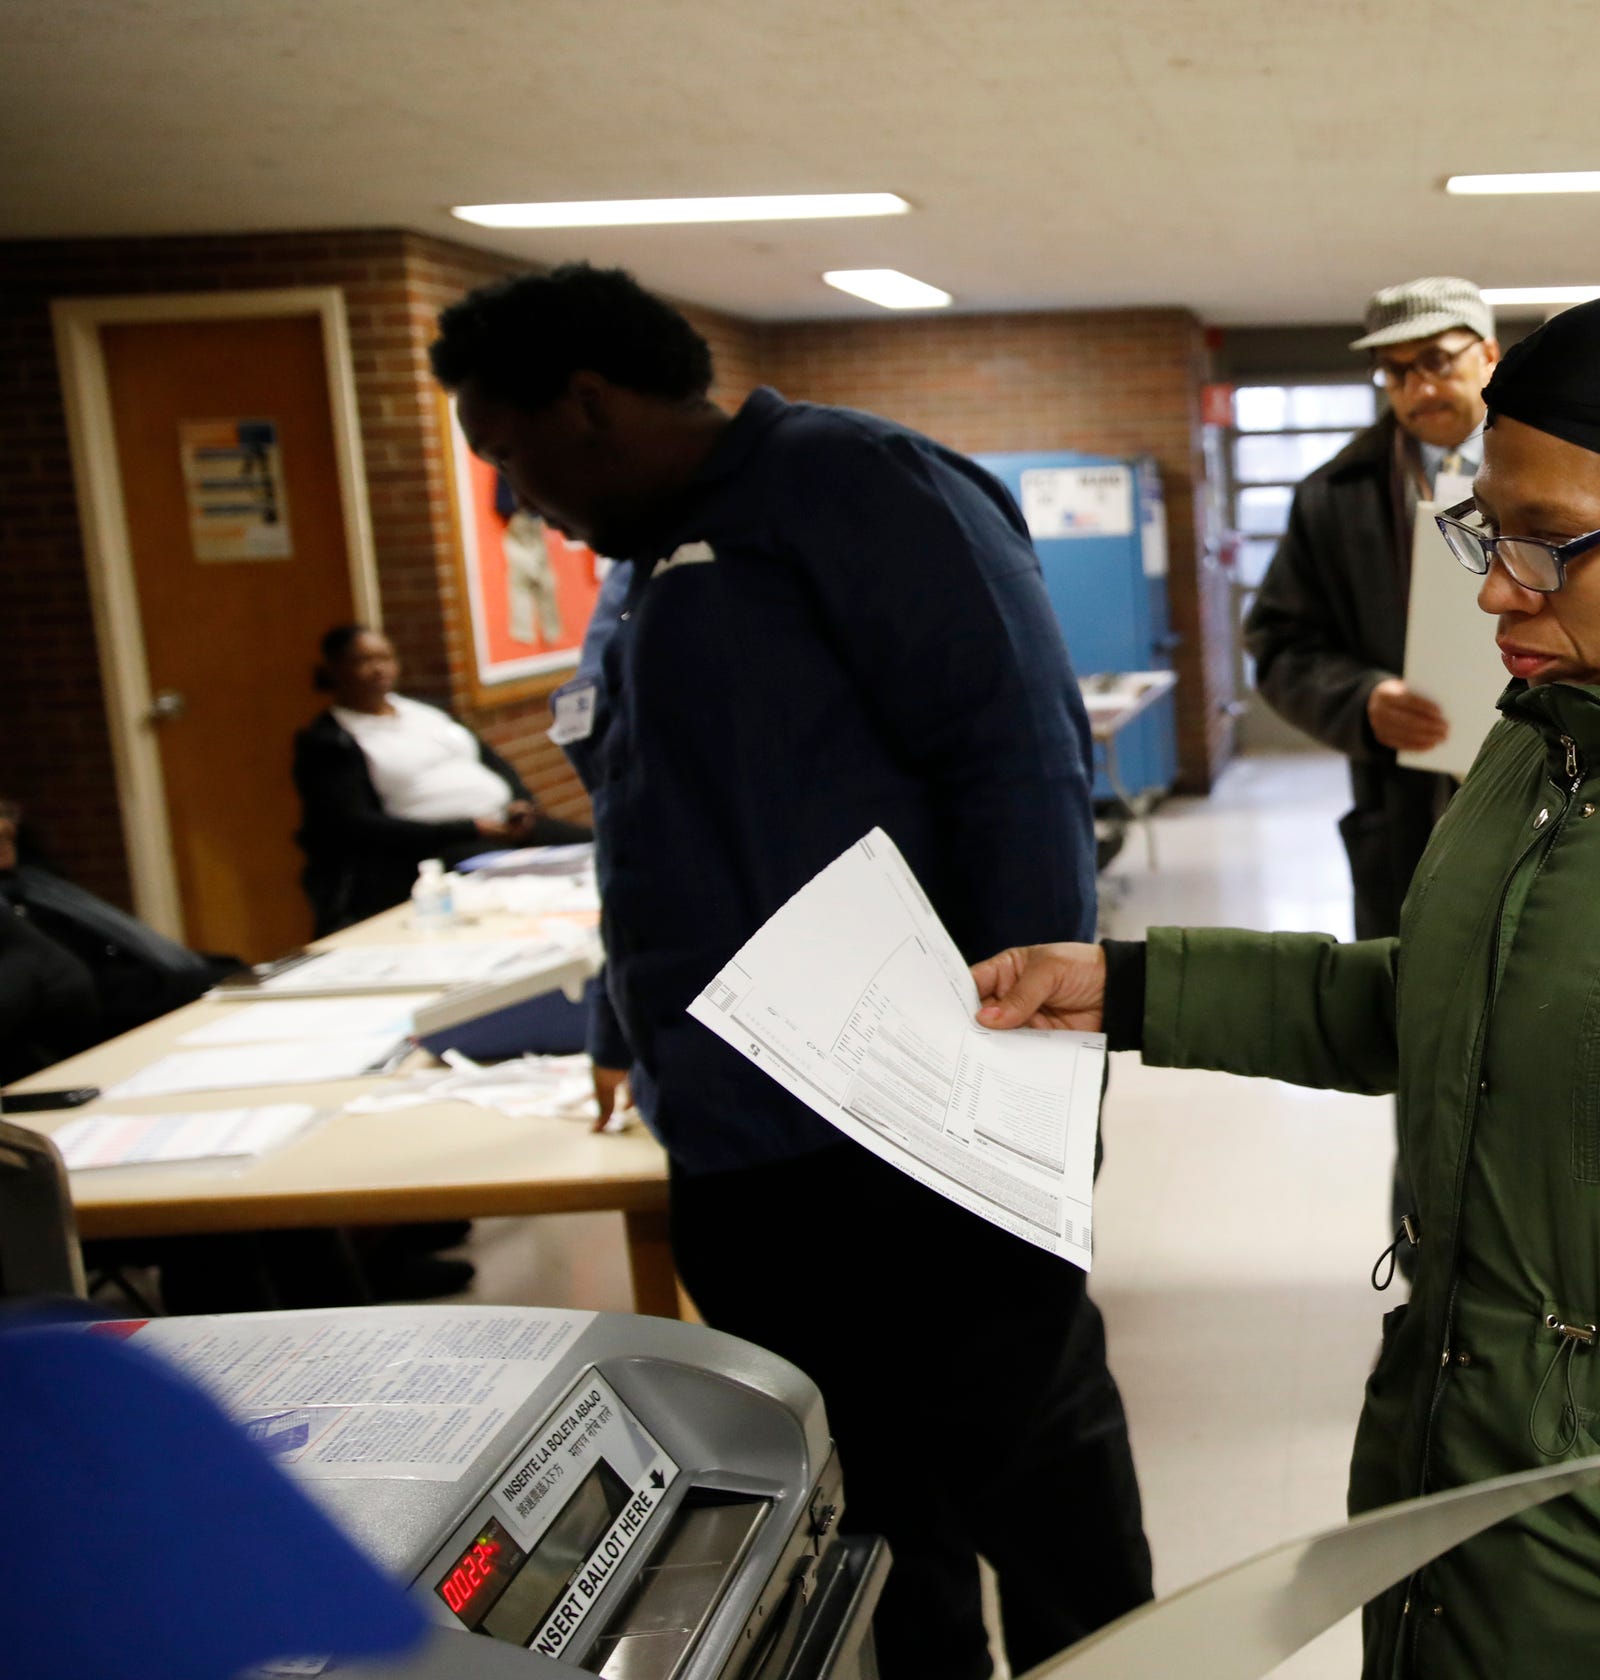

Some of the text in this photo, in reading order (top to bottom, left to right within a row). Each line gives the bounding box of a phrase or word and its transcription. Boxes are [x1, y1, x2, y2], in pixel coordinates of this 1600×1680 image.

[502, 1389, 602, 1502] INSERTE LA BOLETA ABAJO
[441, 1544, 492, 1614] 0022
[535, 1490, 654, 1656] NSERT BALLOT HERE
